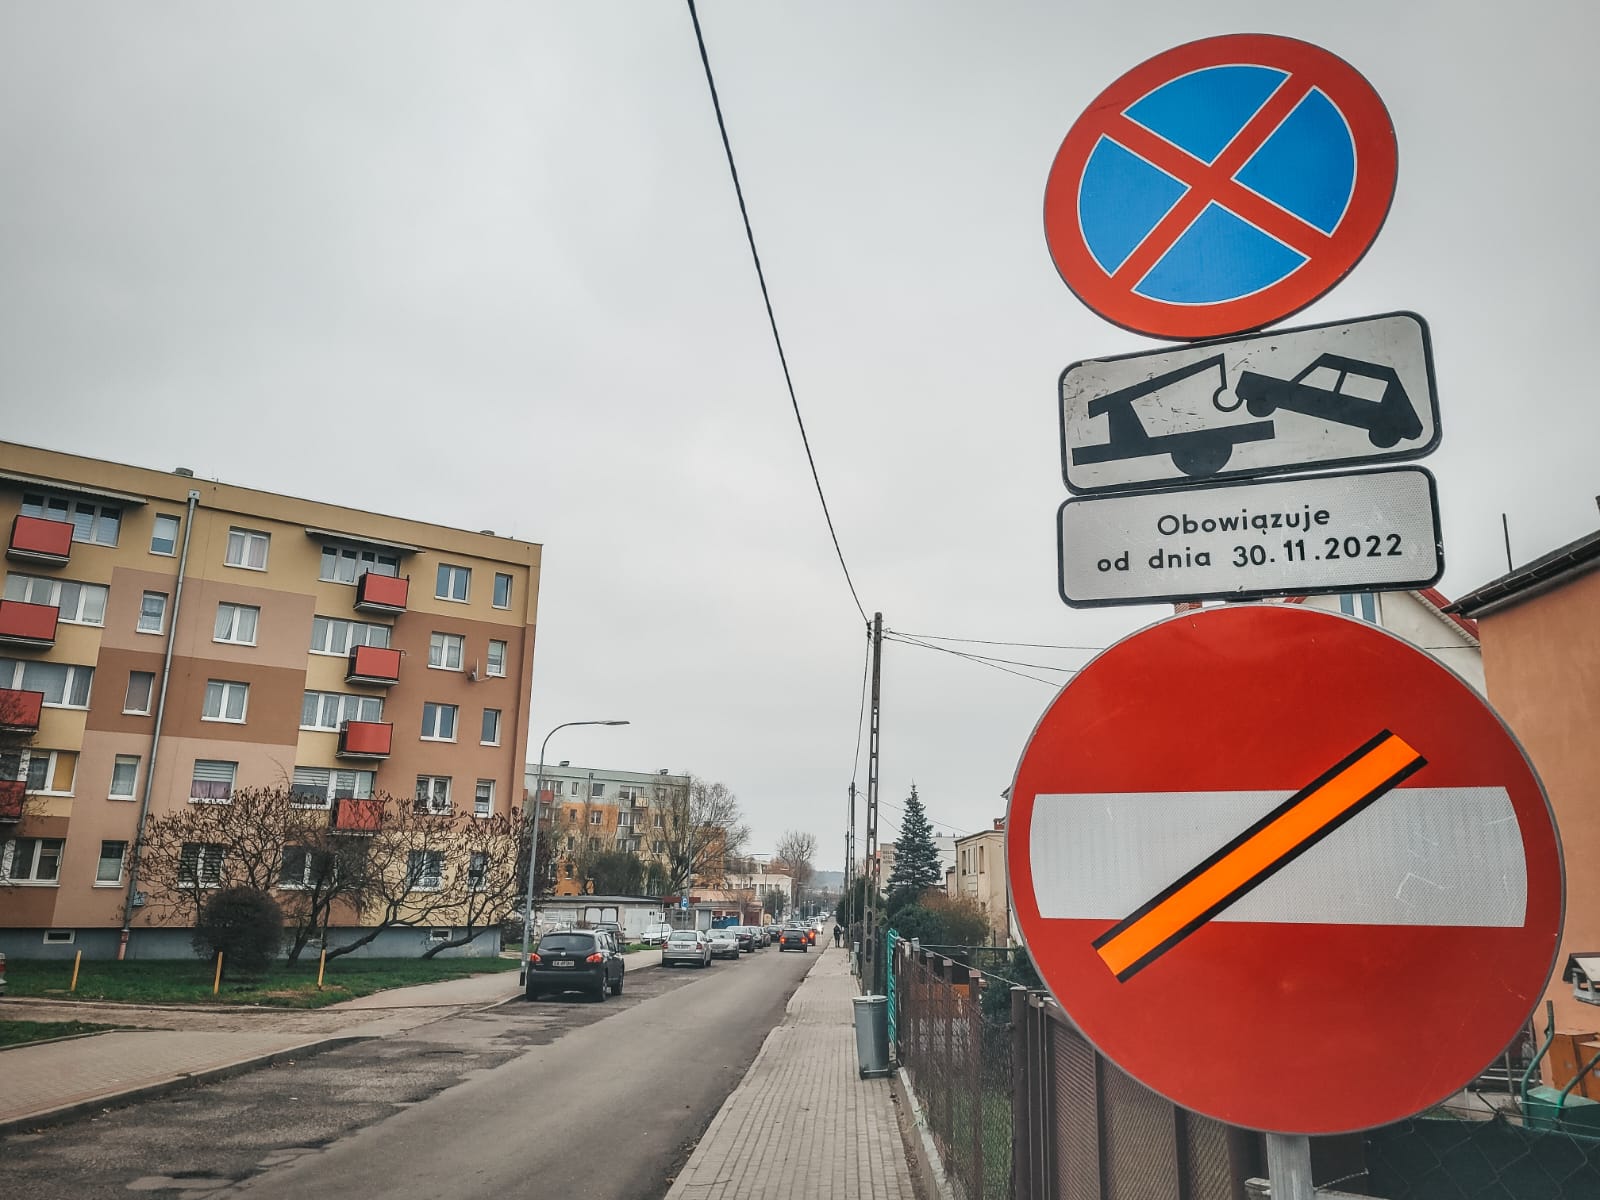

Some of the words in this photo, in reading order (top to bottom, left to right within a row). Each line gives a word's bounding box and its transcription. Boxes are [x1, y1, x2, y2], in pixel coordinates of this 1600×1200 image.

[1156, 504, 1330, 535] Obowiązuje
[1097, 550, 1130, 573] od
[1148, 546, 1211, 569] dnia
[1232, 533, 1403, 568] 30.11.2022
